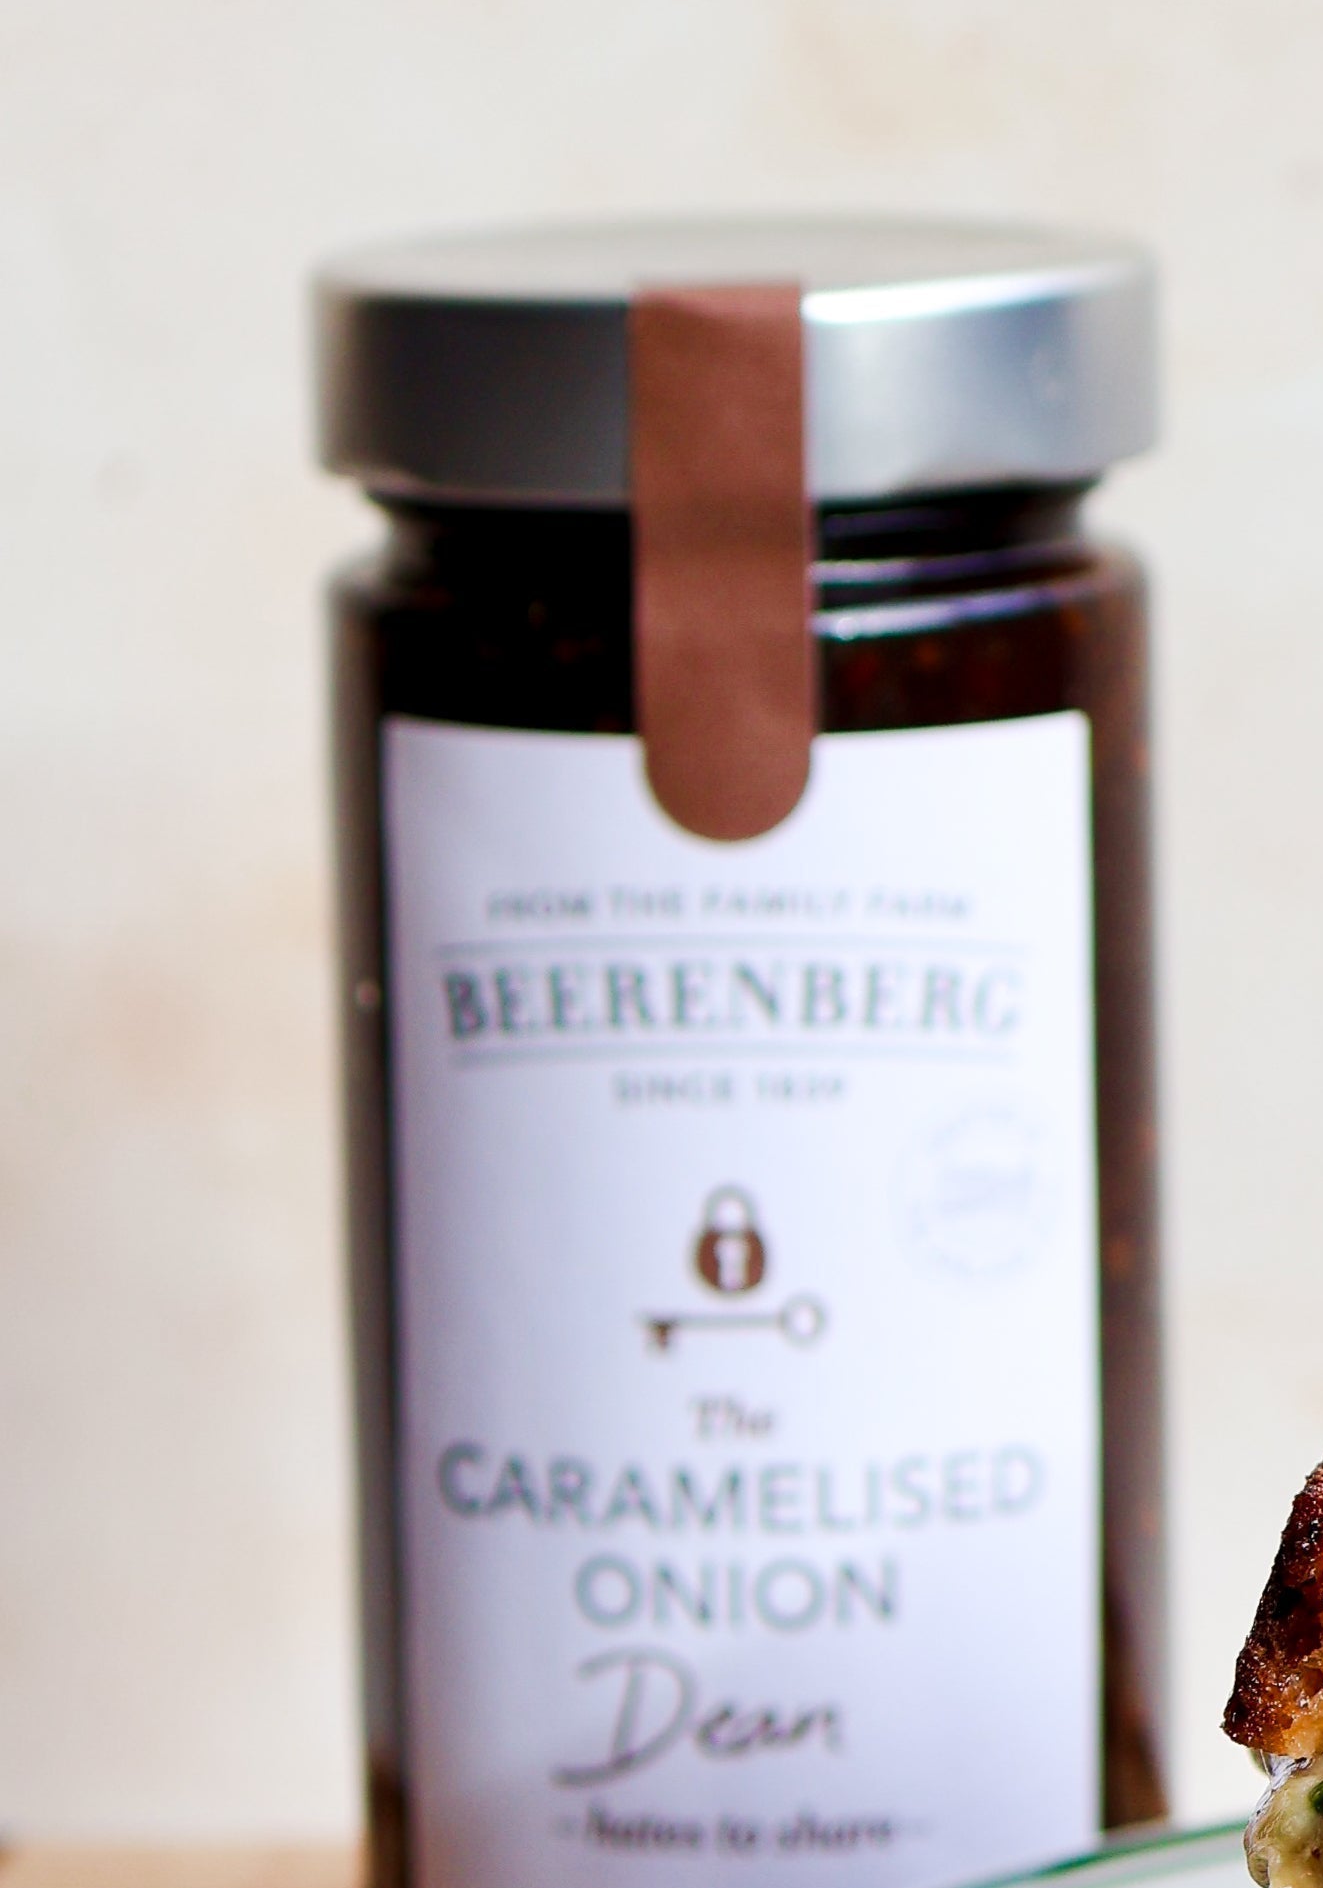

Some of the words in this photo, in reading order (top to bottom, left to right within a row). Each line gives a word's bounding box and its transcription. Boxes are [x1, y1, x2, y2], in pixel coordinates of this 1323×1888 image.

[487, 887, 592, 923] FROM
[609, 885, 683, 921] THE
[699, 886, 850, 922] FAMILY
[443, 961, 1026, 1041] BEERENBERG
[611, 1071, 735, 1106] SINCE
[692, 1395, 776, 1437] The
[434, 1439, 1046, 1537] CARAMELISED
[572, 1555, 900, 1633] ONION
[548, 1645, 846, 1789] Dean
